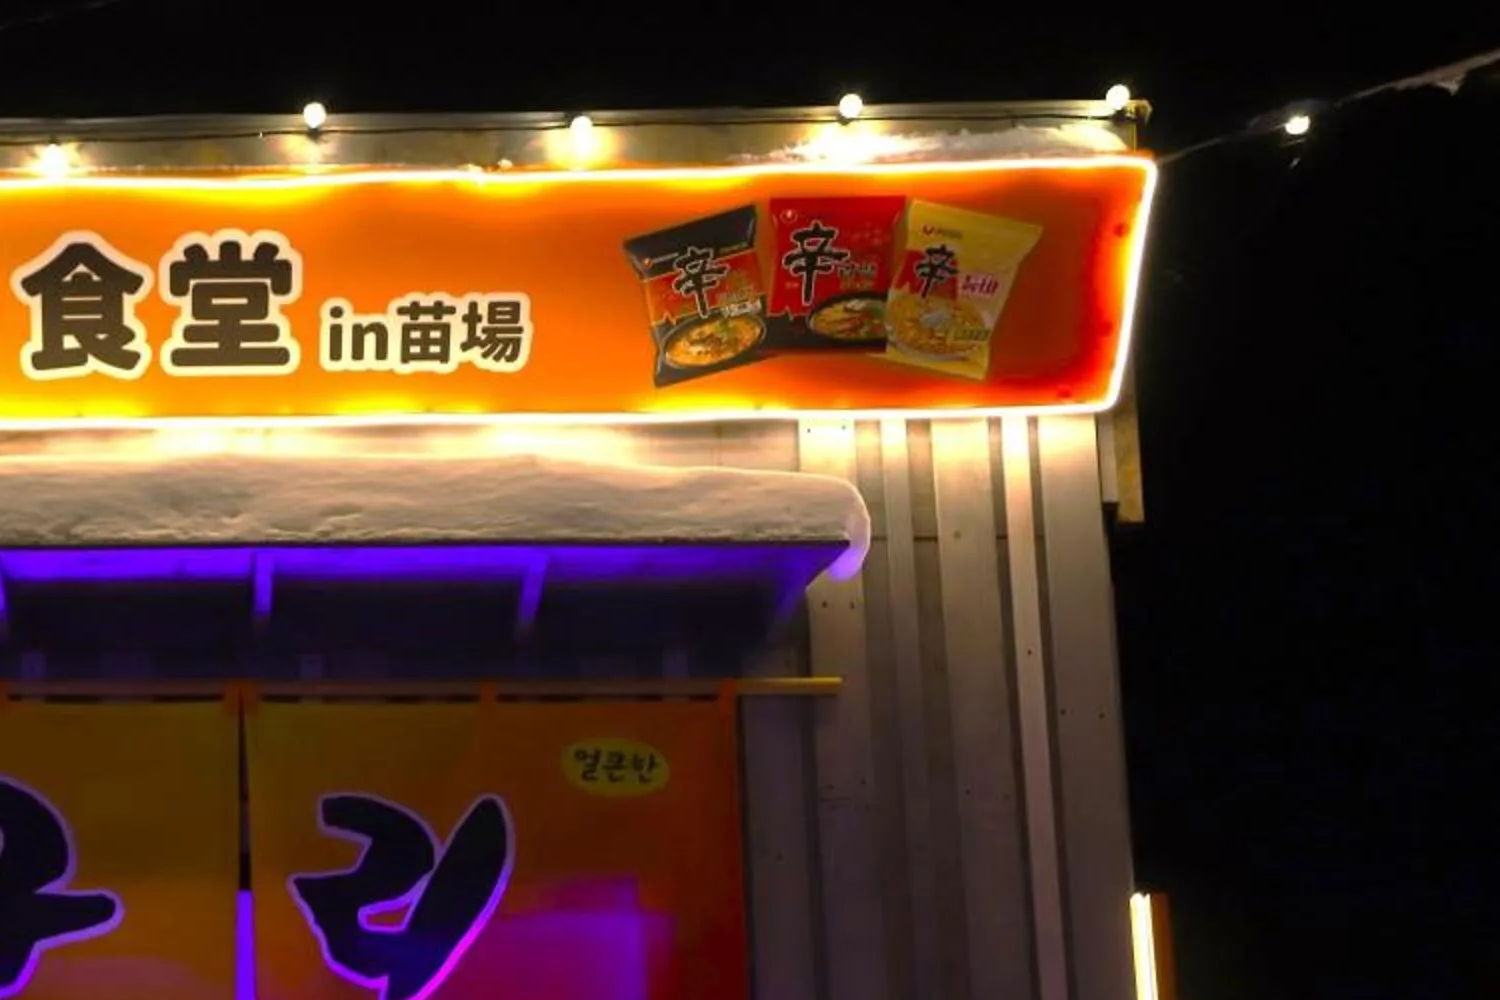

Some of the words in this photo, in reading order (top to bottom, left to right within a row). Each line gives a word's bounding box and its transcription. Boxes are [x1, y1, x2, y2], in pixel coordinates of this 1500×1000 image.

[671, 246, 729, 319] 辛
[781, 220, 850, 306] 辛
[915, 244, 961, 299] 辛
[326, 300, 527, 369] in苗場
